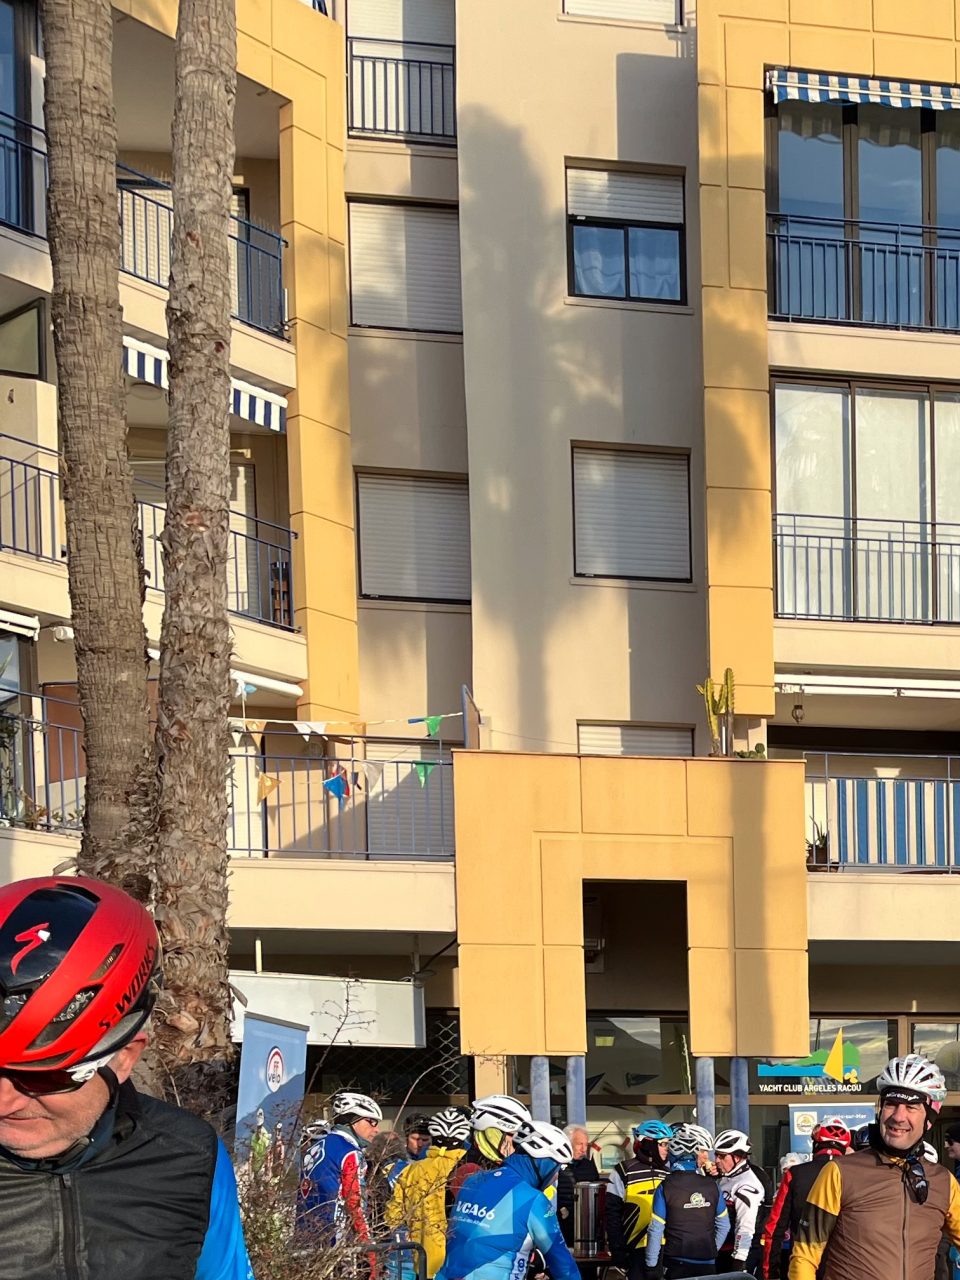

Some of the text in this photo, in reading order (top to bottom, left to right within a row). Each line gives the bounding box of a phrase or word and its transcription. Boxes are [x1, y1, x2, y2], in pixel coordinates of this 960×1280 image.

[759, 1084, 862, 1092] YACHT CLUB ARGELES RACOU
[456, 1200, 495, 1220] VCA66
